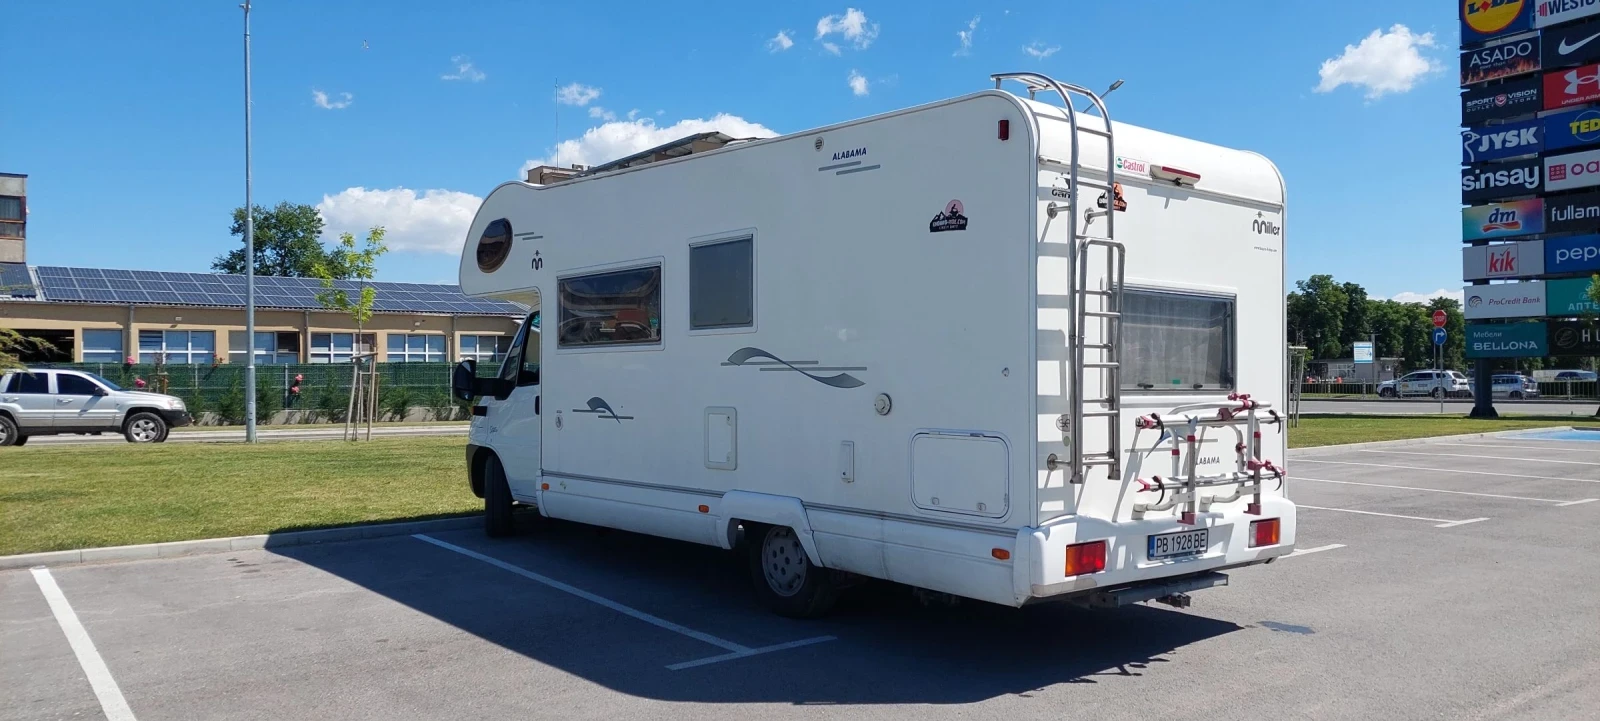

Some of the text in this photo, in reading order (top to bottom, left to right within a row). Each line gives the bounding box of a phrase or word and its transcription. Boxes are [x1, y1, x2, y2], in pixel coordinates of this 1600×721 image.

[1470, 42, 1532, 67] ASADO
[1466, 89, 1537, 107] SPORT VISION
[1466, 96, 1536, 112] OUTLET STORE
[1478, 126, 1538, 152] JYSK
[832, 147, 867, 161] ALABAMA
[1123, 159, 1145, 173] Castrol
[1462, 166, 1540, 191] sinsay
[1489, 207, 1516, 223] dm
[1552, 205, 1600, 221] fullam
[1253, 219, 1280, 236] Miller
[1556, 246, 1600, 264] pep
[1473, 341, 1538, 350] BELLONA
[1156, 532, 1206, 554] PB 1928 BE
